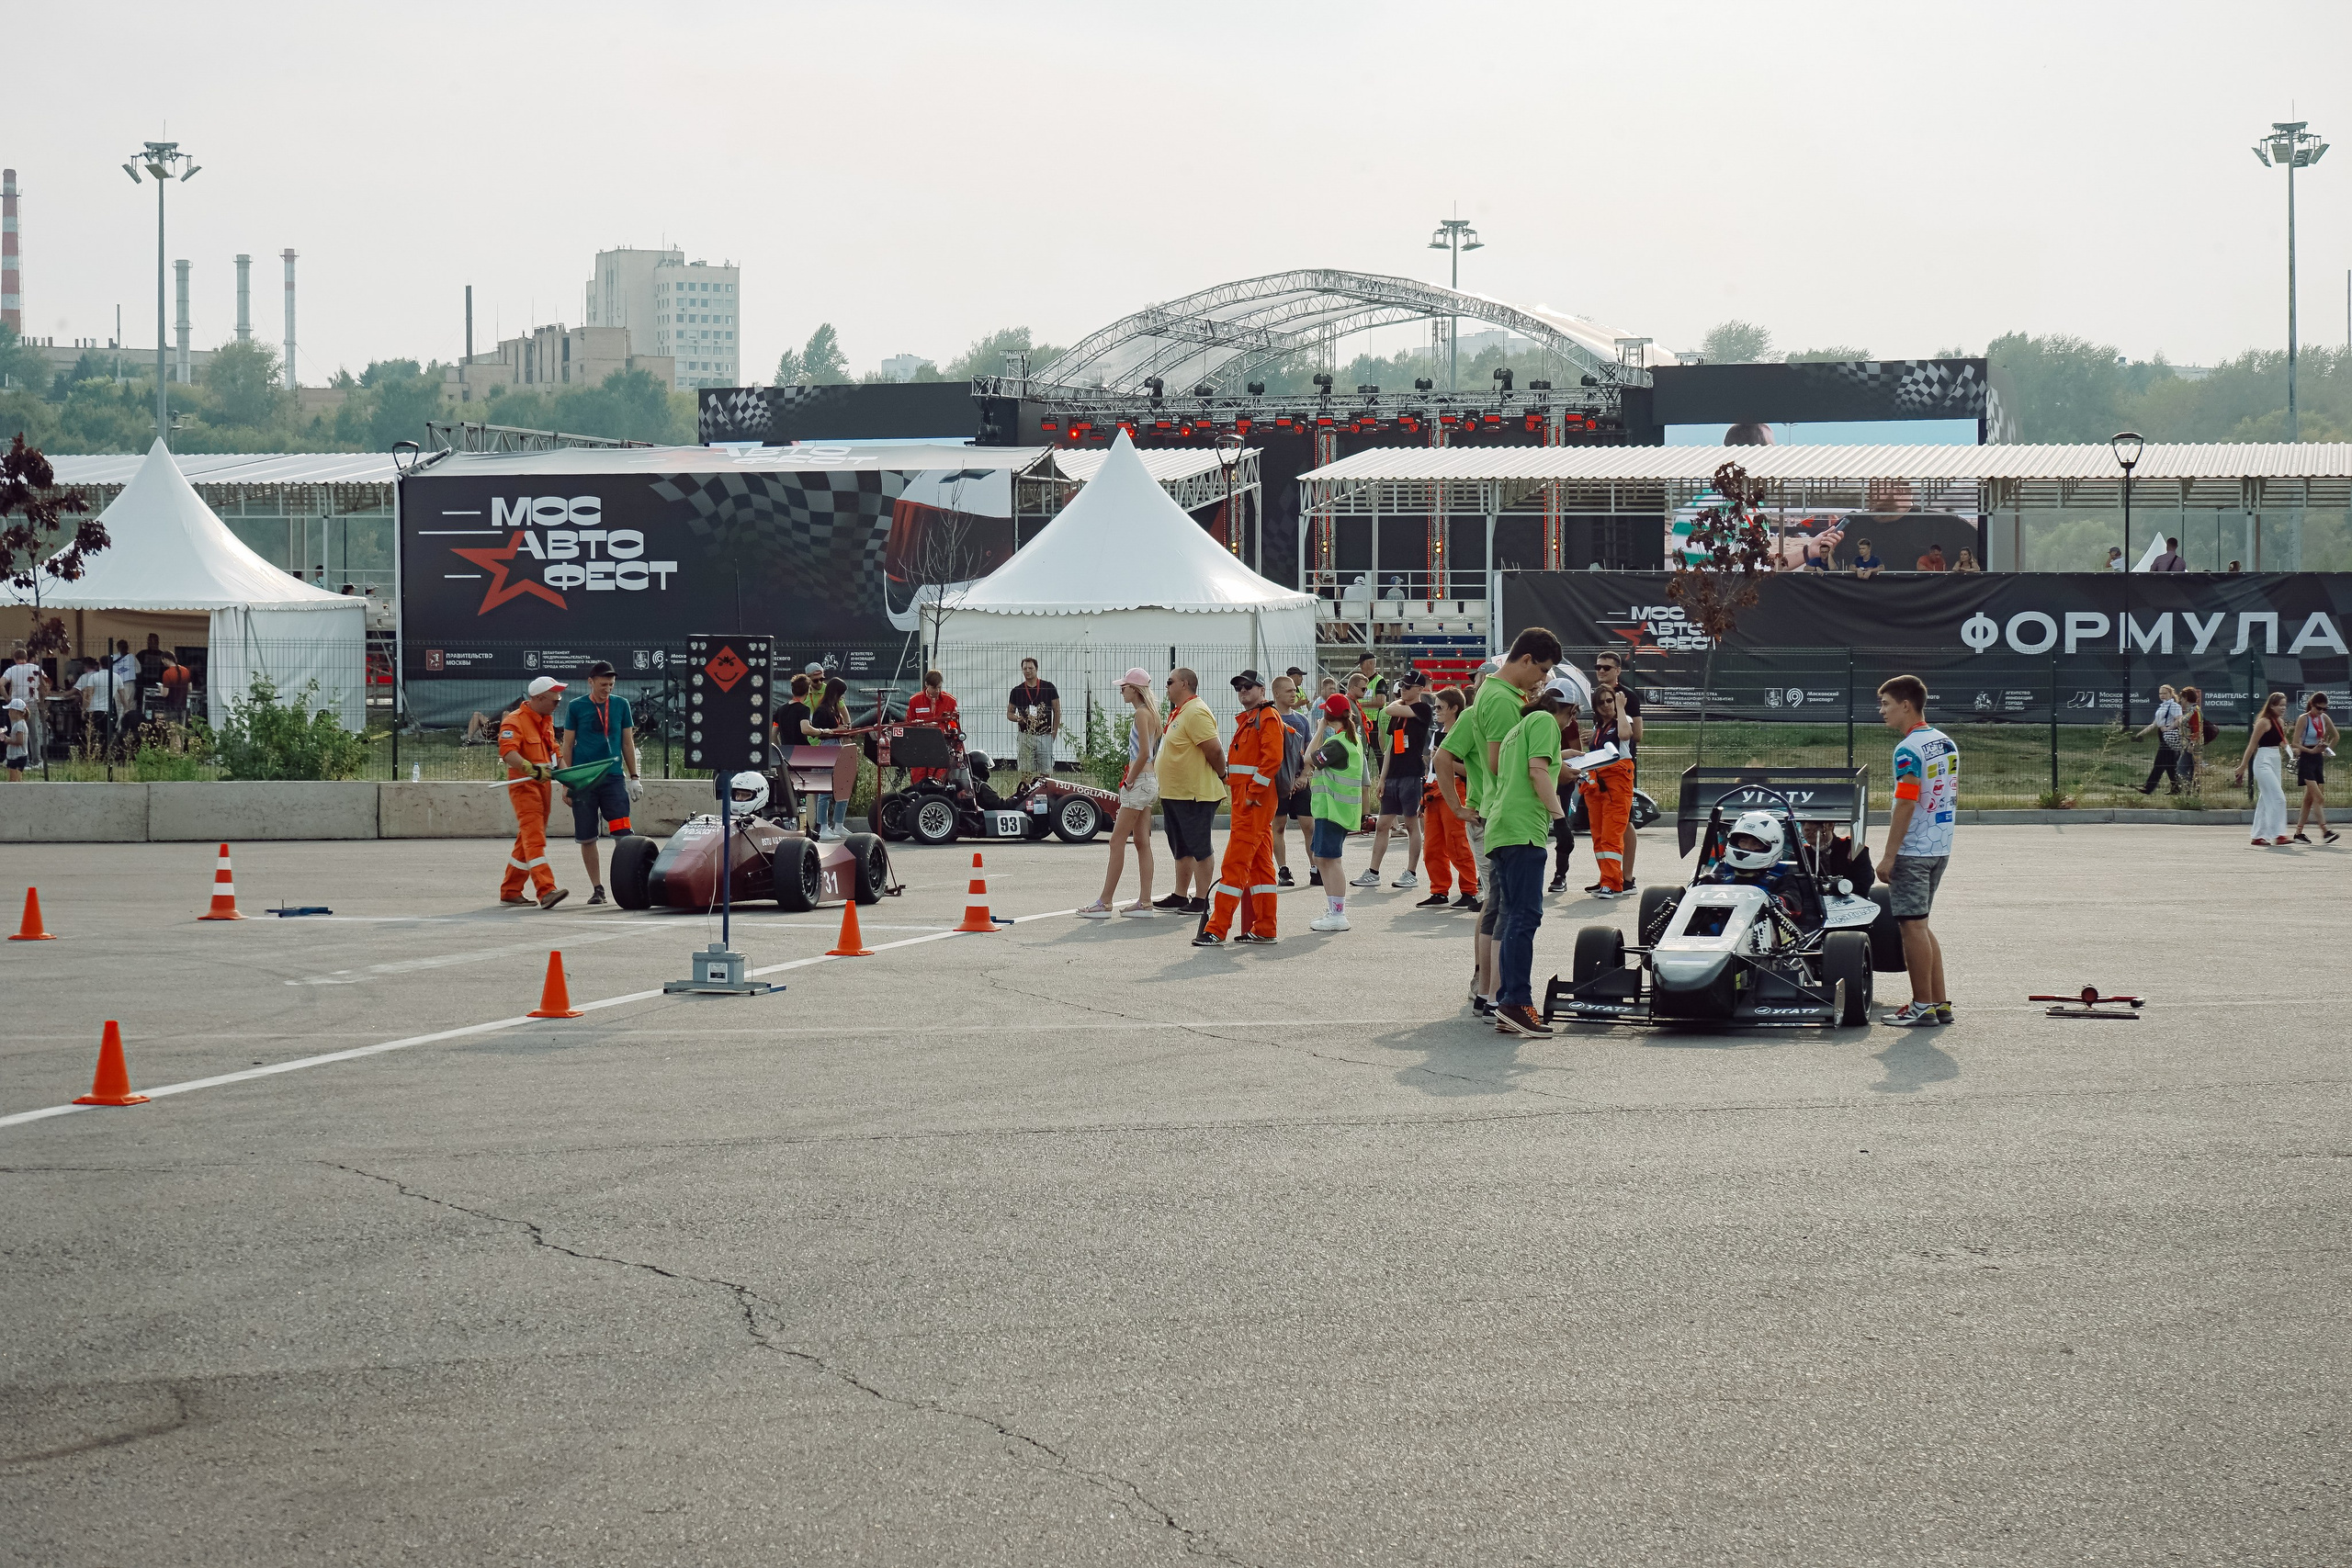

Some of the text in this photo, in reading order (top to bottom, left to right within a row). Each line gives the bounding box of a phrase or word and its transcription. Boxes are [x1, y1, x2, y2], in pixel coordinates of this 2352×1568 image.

[732, 454, 878, 465] ФЕСТ
[492, 496, 601, 526] МОС
[515, 529, 644, 559] АВТО
[544, 560, 678, 591] ФЕСТ
[1631, 606, 1685, 620] МОС
[1644, 621, 1706, 636] АВТО
[1961, 611, 2350, 655] ФОРМУЛА
[894, 728, 903, 737] RS
[1055, 781, 1116, 802] TSU TOGLIATTI
[1742, 791, 1815, 803] УГАТУ
[1000, 817, 1018, 832] 93
[823, 871, 839, 895] 31
[1827, 906, 1879, 924] ugatu.su
[1585, 1004, 1634, 1012] УГАТУ
